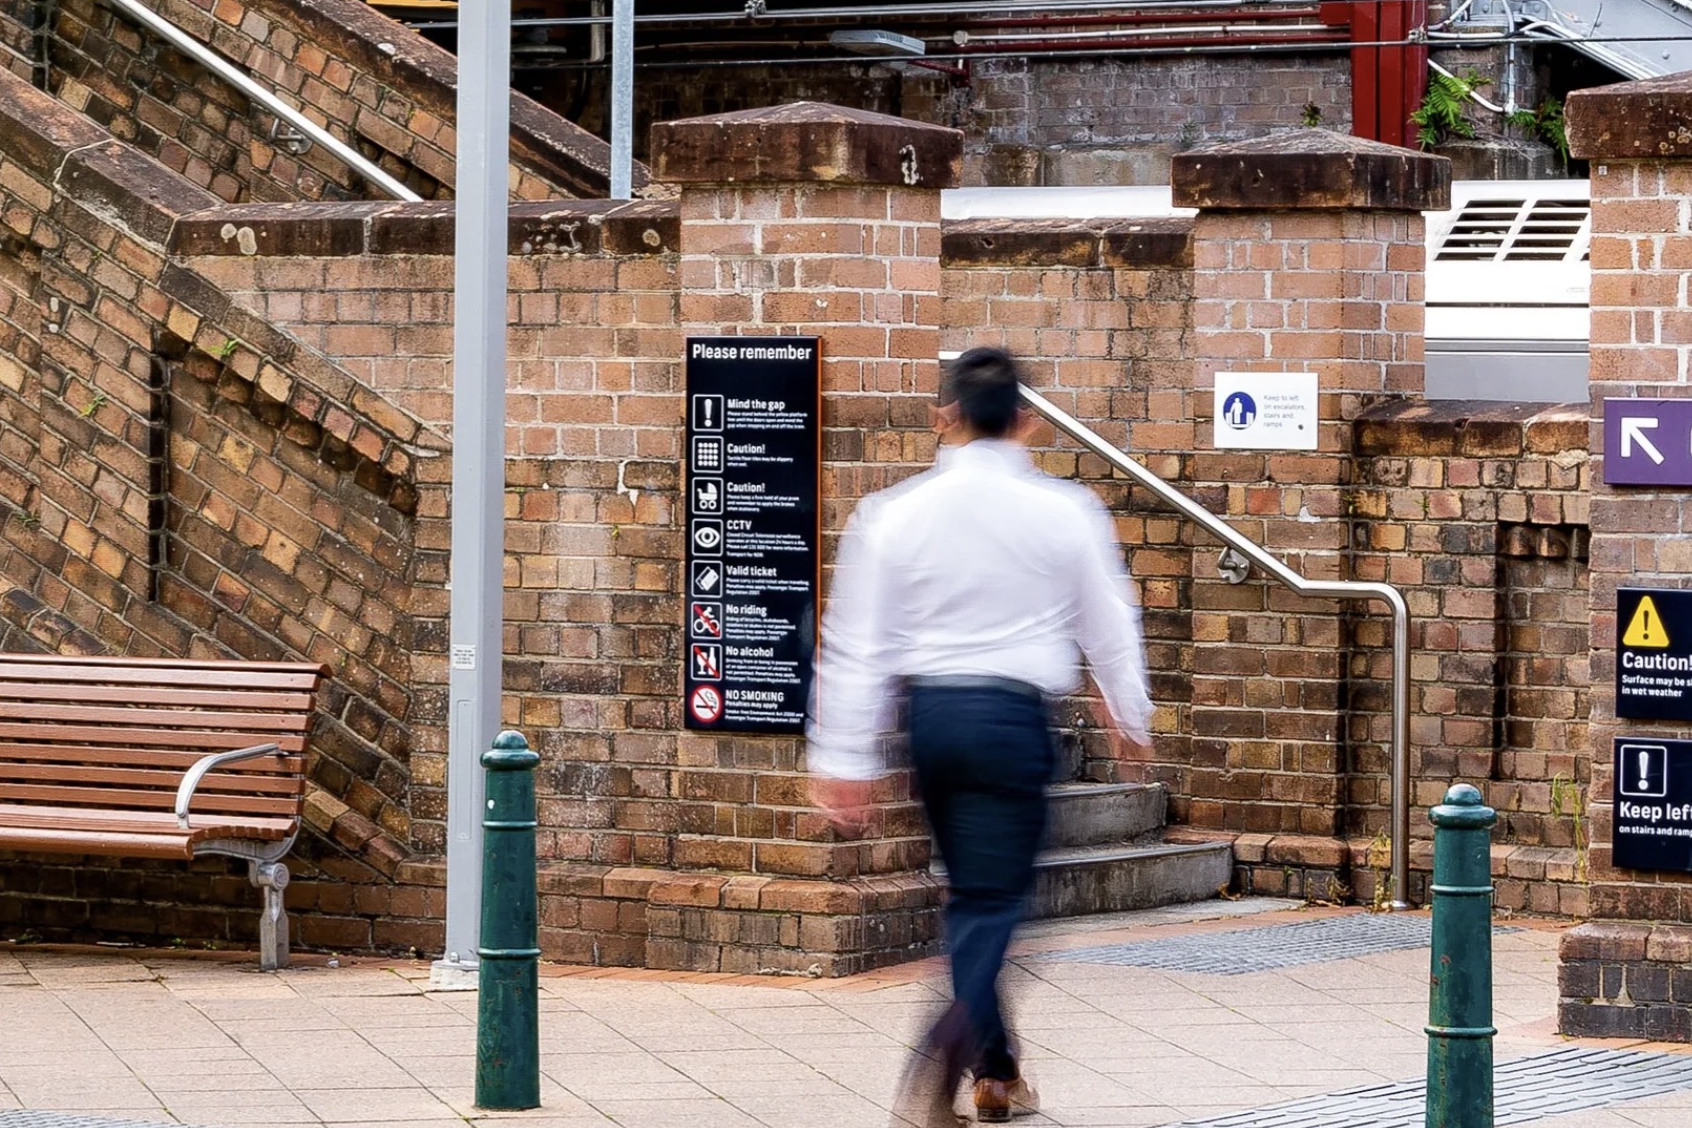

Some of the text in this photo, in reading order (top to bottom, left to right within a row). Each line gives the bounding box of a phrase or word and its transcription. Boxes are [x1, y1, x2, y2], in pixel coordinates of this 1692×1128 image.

[692, 343, 812, 360] Please remember
[727, 399, 786, 411] Mind the gap
[727, 443, 765, 454] Caution!
[727, 482, 765, 492] Caution!
[727, 520, 752, 530] CCTV
[726, 565, 777, 576] Valid ticket
[726, 604, 767, 617] No riding
[726, 646, 774, 657] No alcohol
[1622, 651, 1692, 671] Caution!
[1621, 674, 1655, 686] Surface
[1656, 677, 1673, 687] may
[1674, 677, 1685, 686] be
[725, 690, 785, 702] NO SMOKING
[1622, 685, 1682, 697] in wet weather
[1619, 801, 1662, 823] Keep
[1619, 825, 1630, 833] on
[1631, 825, 1655, 835] stairs
[1656, 827, 1673, 836] and
